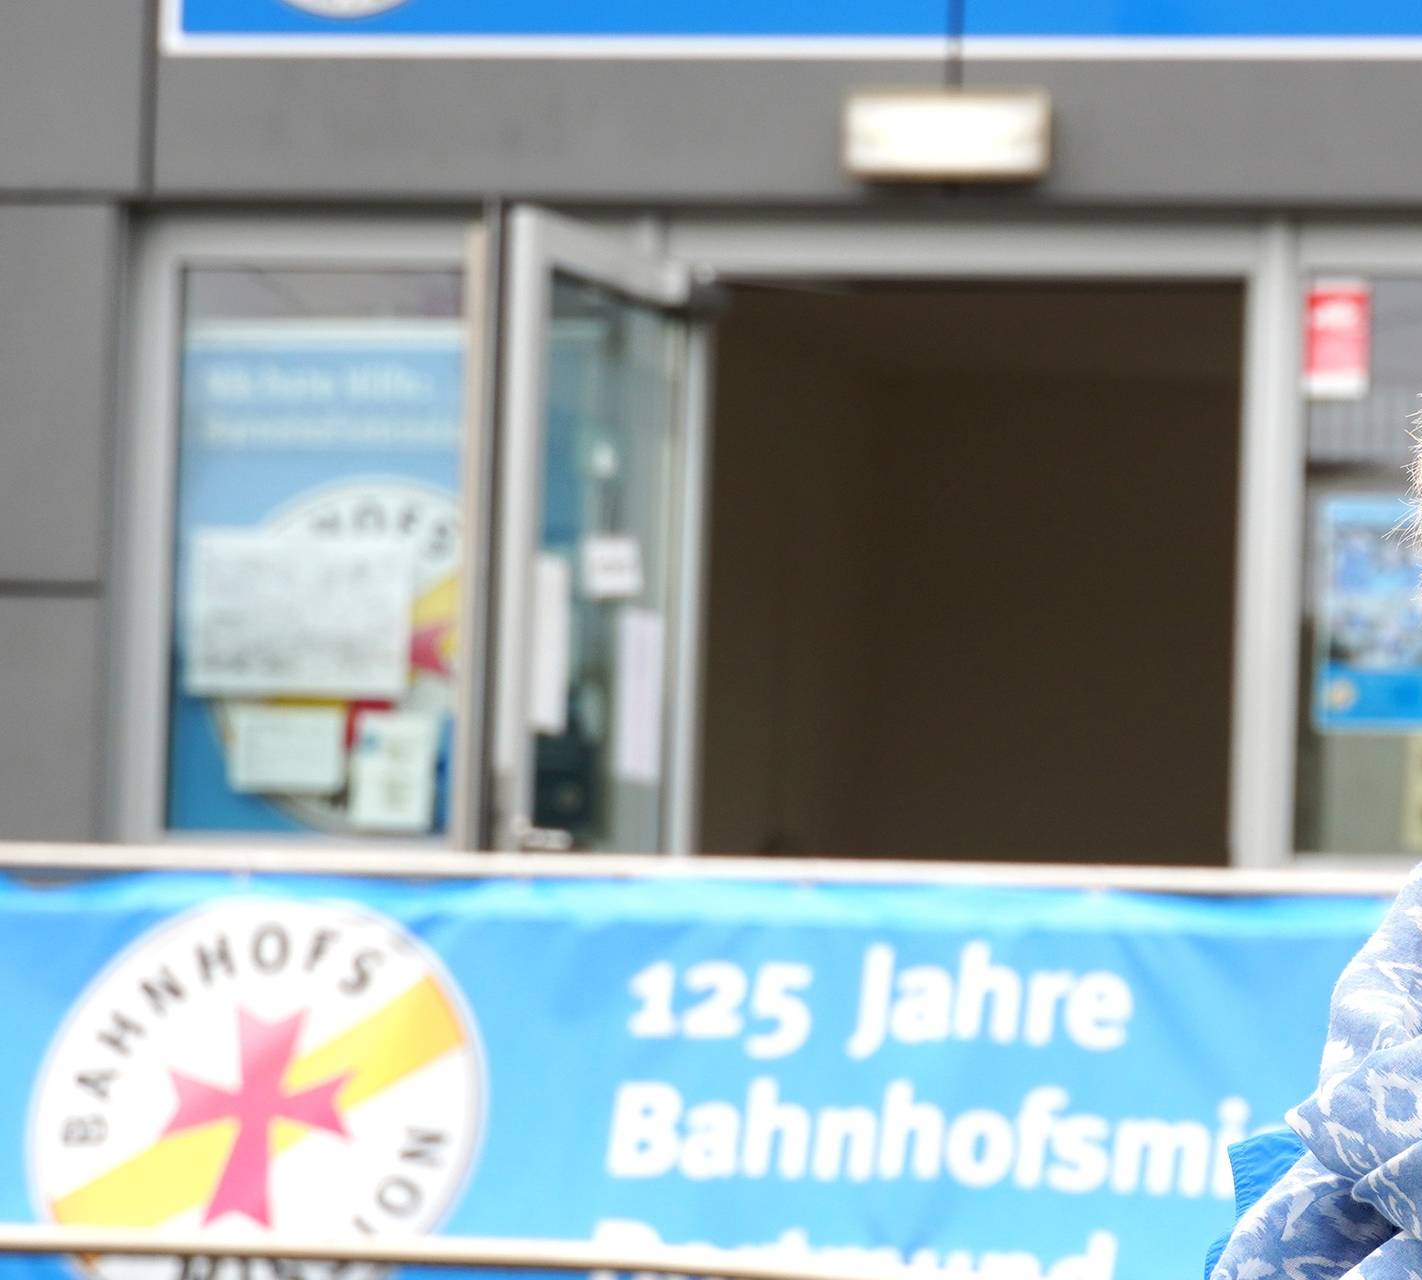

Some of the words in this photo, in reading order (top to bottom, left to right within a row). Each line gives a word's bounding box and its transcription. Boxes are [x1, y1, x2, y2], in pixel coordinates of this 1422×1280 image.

[61, 922, 388, 1147] BAHNHOFS
[628, 960, 813, 1060] 125
[846, 939, 1134, 1060] Jahre
[605, 1075, 1288, 1201] Bahnhofsmi
